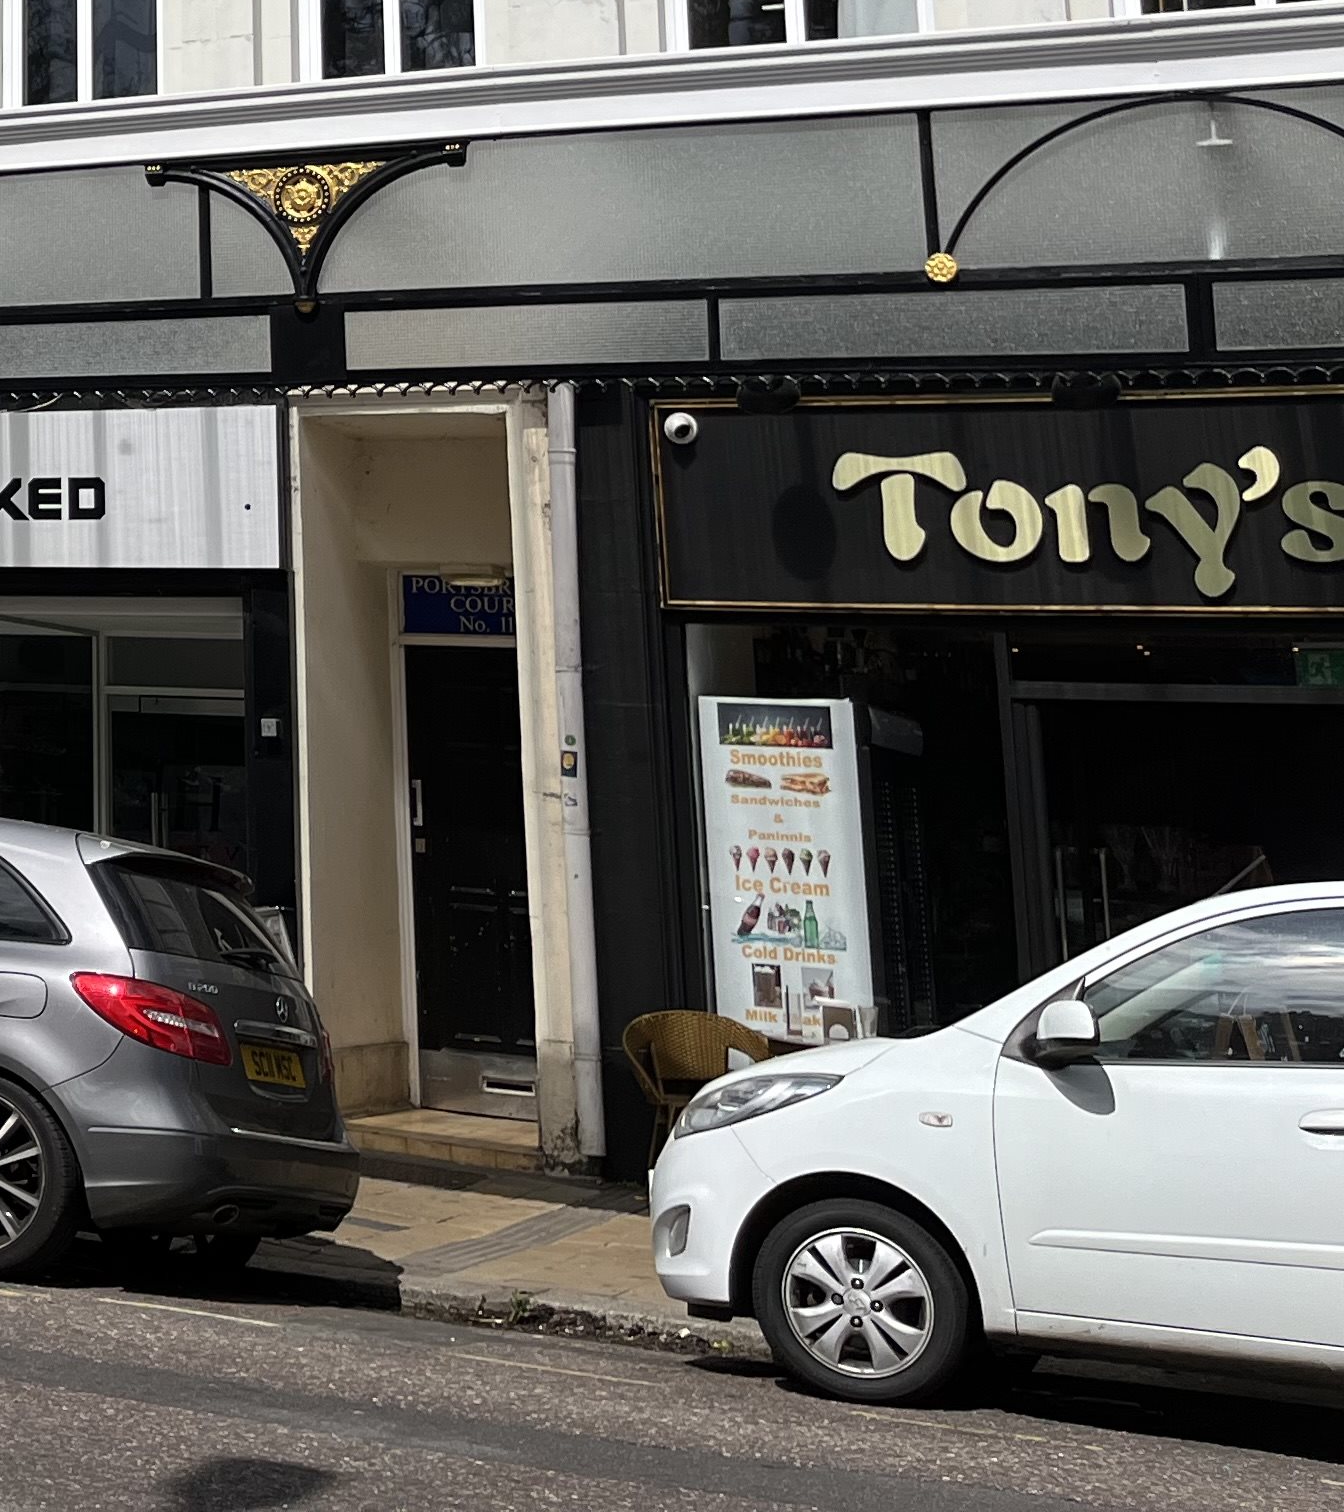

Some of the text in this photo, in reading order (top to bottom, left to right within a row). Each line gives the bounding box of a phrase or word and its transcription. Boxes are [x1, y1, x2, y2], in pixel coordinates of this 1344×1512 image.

[458, 615, 491, 633] No.
[730, 748, 824, 768] Smoothies
[730, 793, 821, 809] Sandwiches
[773, 813, 785, 824] &
[734, 873, 833, 897] Ice Cream
[741, 944, 838, 965] Cold Drinks
[744, 1008, 779, 1024] Milk
